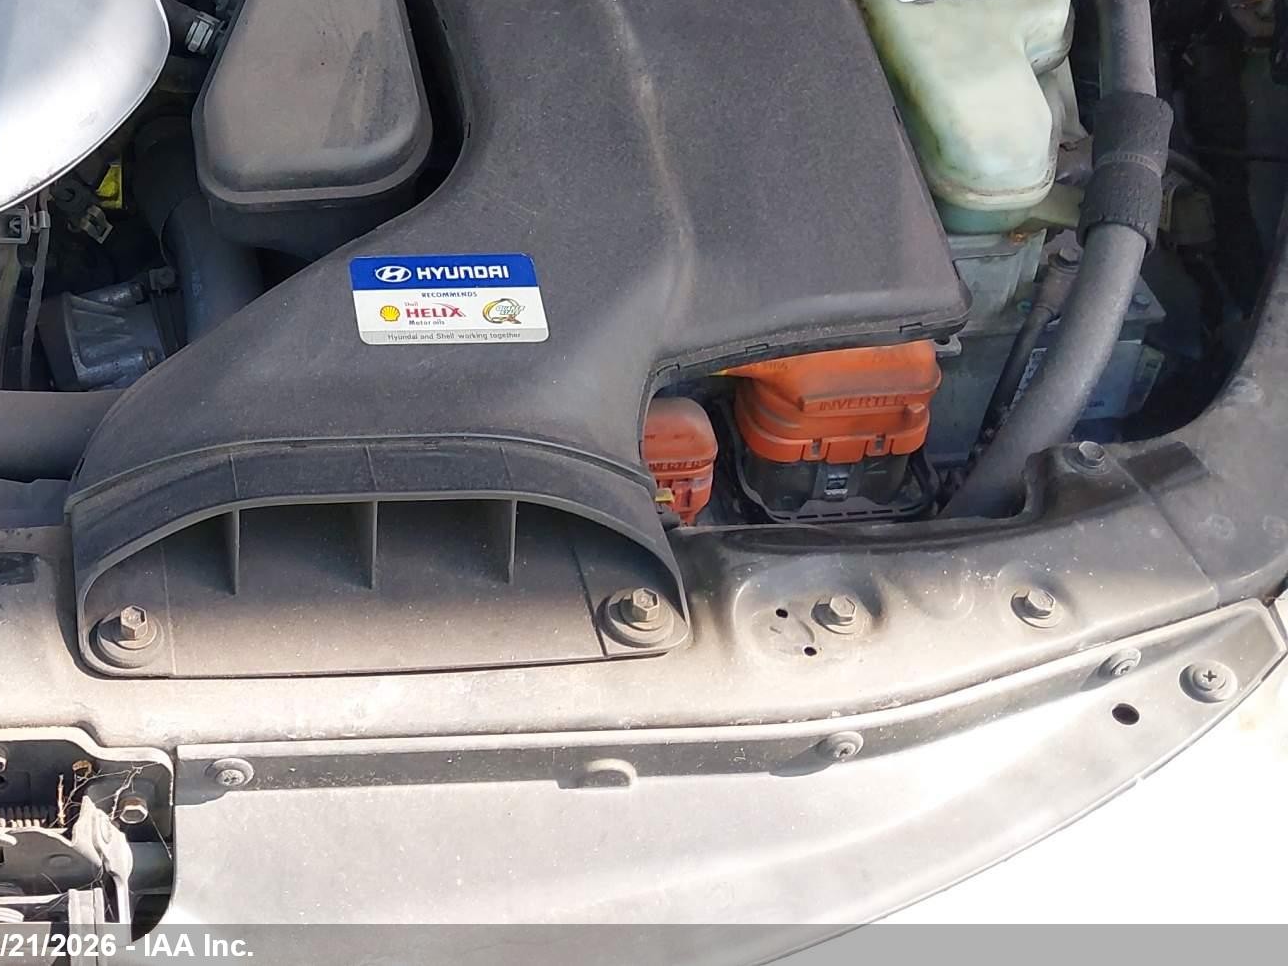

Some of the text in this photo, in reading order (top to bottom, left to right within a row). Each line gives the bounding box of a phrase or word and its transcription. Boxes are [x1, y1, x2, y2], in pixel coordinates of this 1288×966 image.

[416, 265, 510, 280] HYUNDAI
[406, 307, 464, 318] HELIX
[387, 333, 418, 341] Hyundai
[436, 332, 455, 340] Shell
[457, 332, 488, 340] working
[489, 331, 521, 340] together
[819, 395, 906, 411] INVERTER
